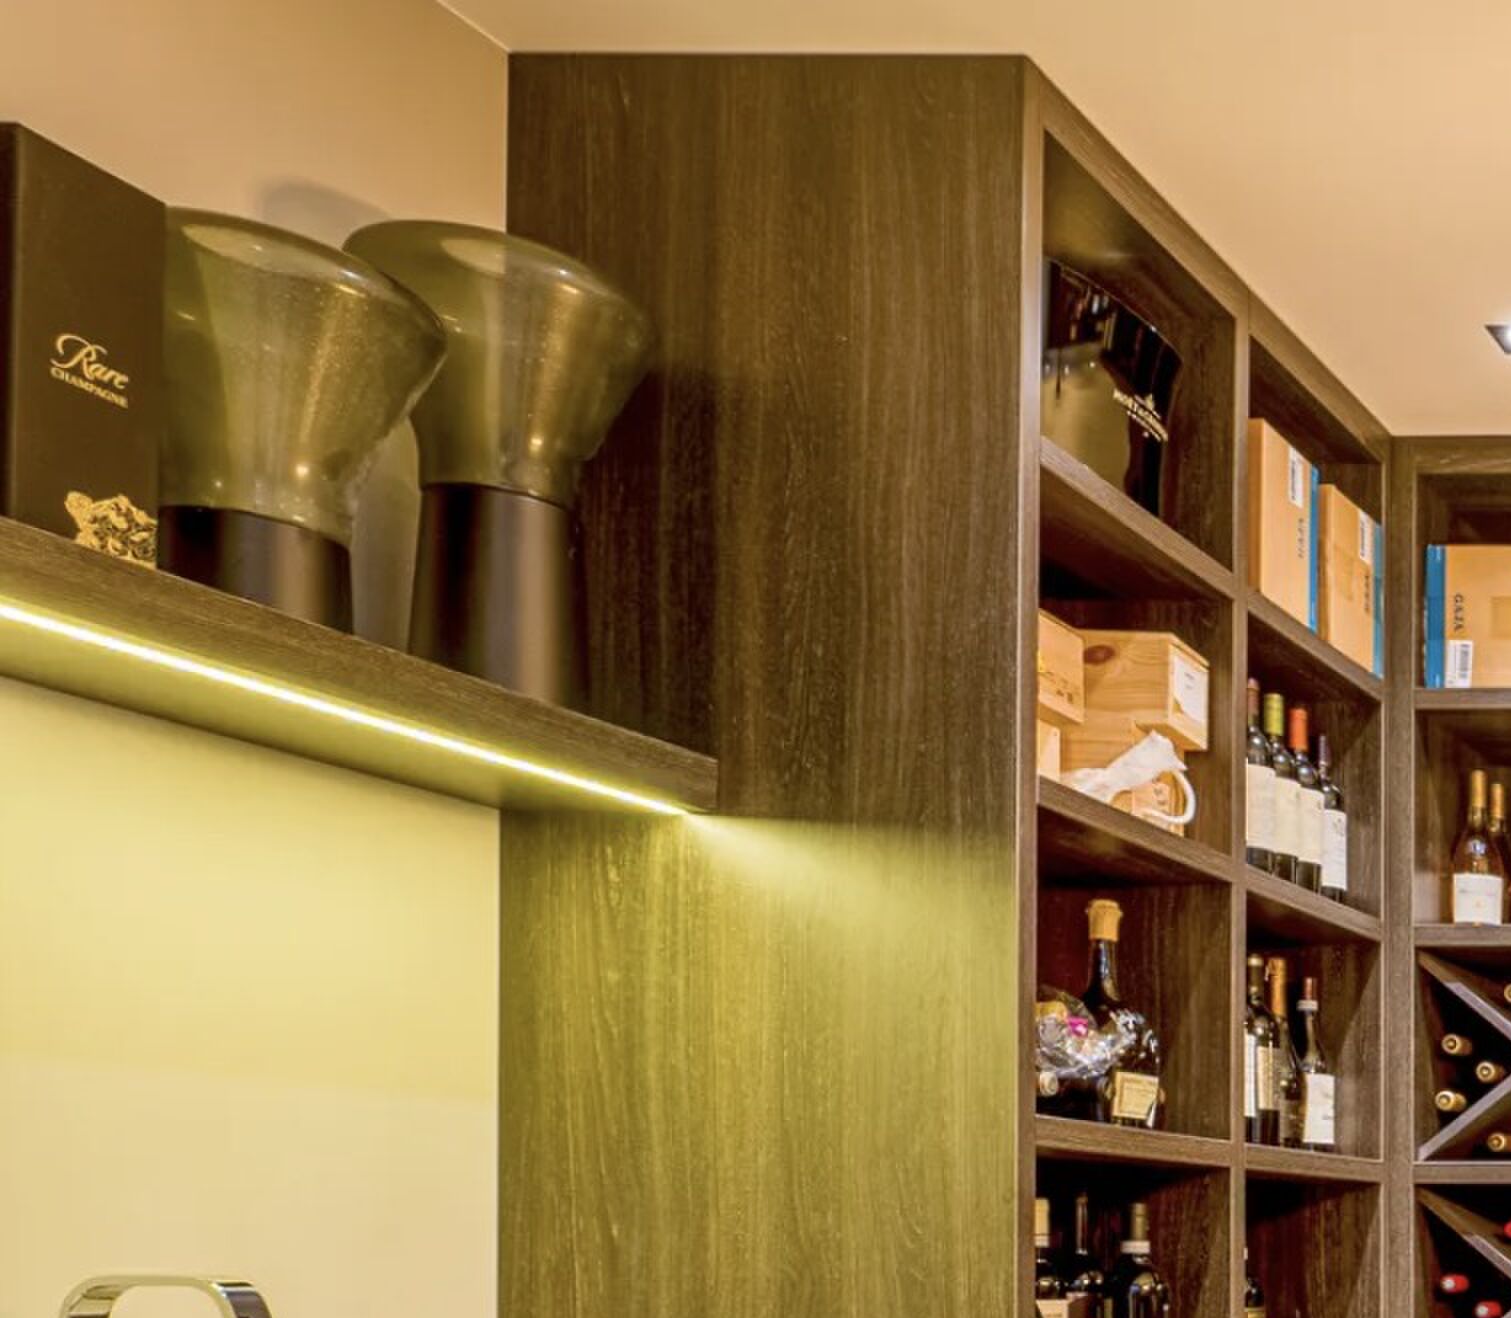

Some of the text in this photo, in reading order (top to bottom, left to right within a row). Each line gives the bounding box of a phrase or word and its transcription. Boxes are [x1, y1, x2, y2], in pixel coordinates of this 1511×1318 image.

[50, 332, 129, 390] Rare
[50, 366, 128, 409] CHAMPAGNE
[1453, 593, 1465, 632] GAJA
